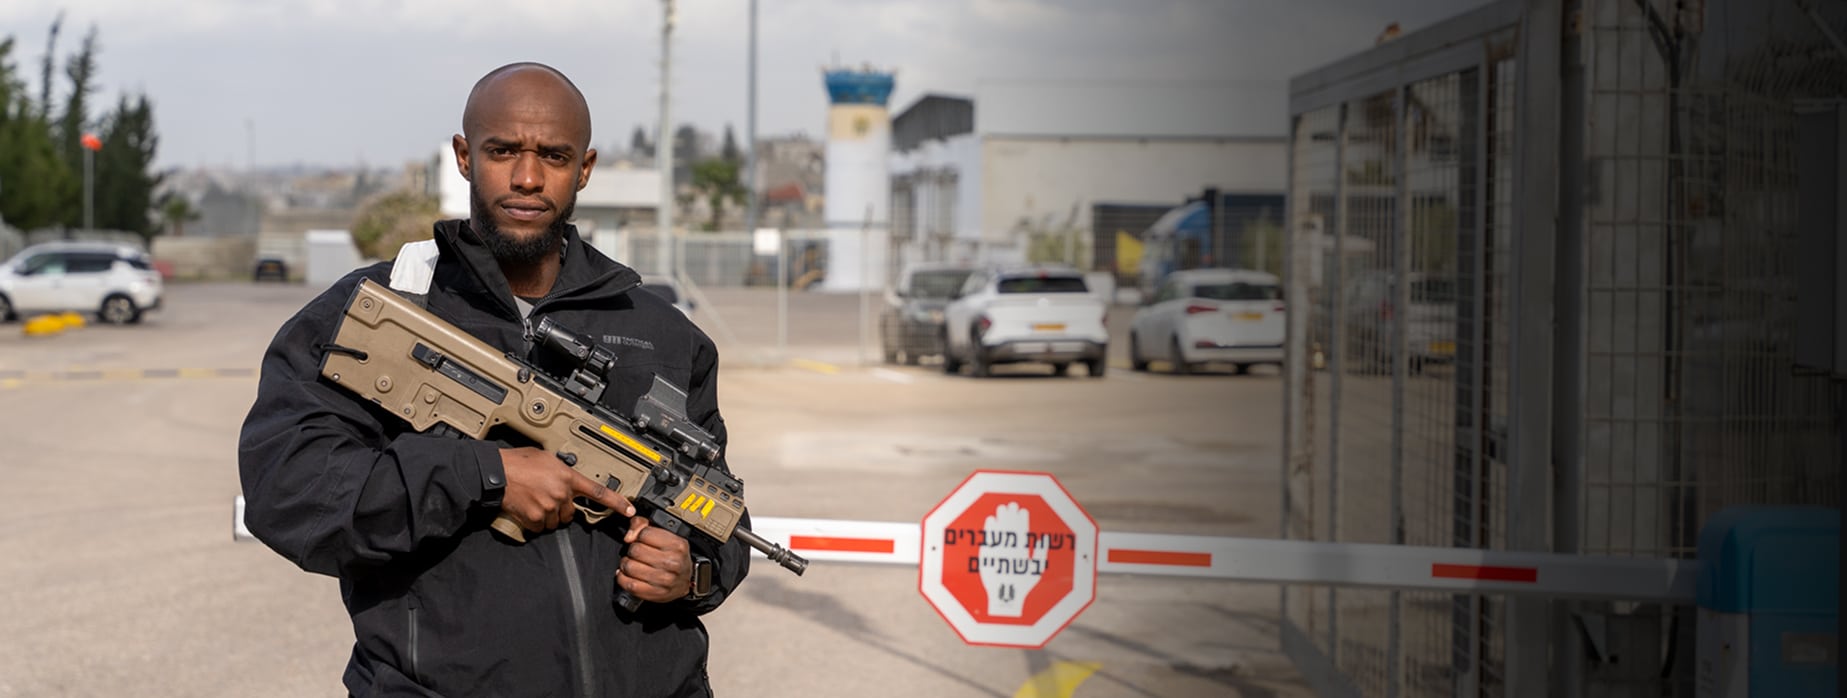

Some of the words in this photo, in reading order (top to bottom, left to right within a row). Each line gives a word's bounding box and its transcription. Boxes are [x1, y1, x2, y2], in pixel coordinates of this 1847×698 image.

[944, 528, 1017, 547] מעברים
[1025, 532, 1076, 550] רשות
[968, 556, 1048, 576] יבשתיים
